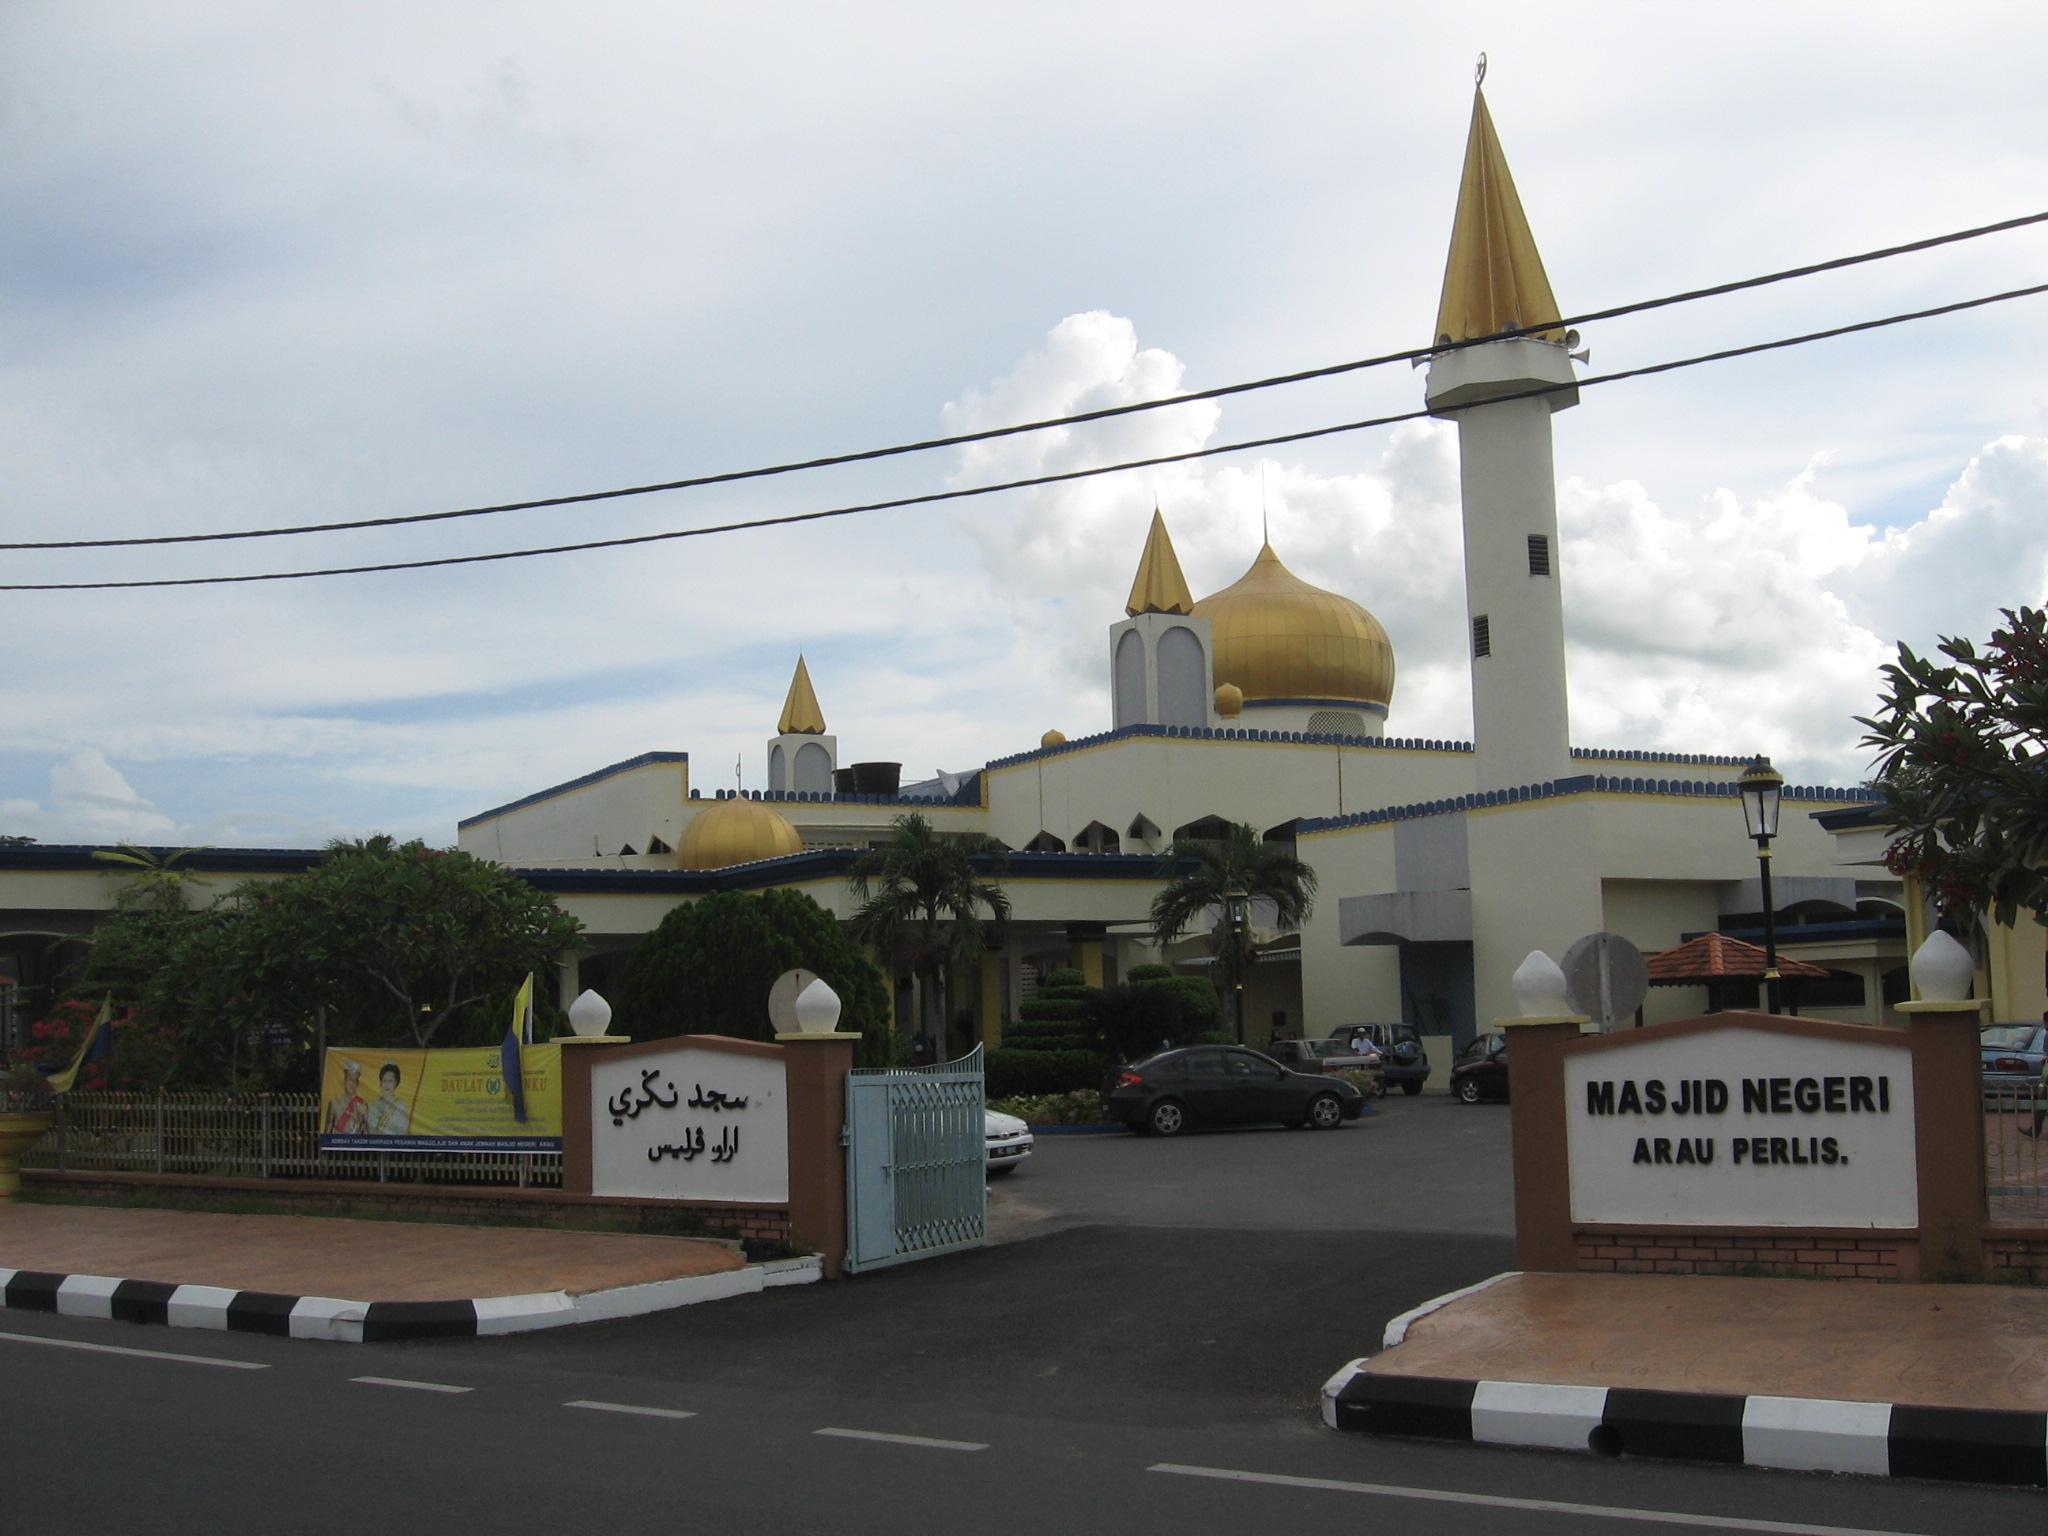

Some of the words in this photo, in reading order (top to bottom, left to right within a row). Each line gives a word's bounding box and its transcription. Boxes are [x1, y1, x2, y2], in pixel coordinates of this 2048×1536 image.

[441, 1079, 483, 1093] DAULAT
[1586, 1079, 1729, 1115] MASJID
[1741, 1075, 1890, 1114] NEGERI
[1633, 1137, 1714, 1165] ARAU
[1732, 1136, 1849, 1165] PERLIS.
